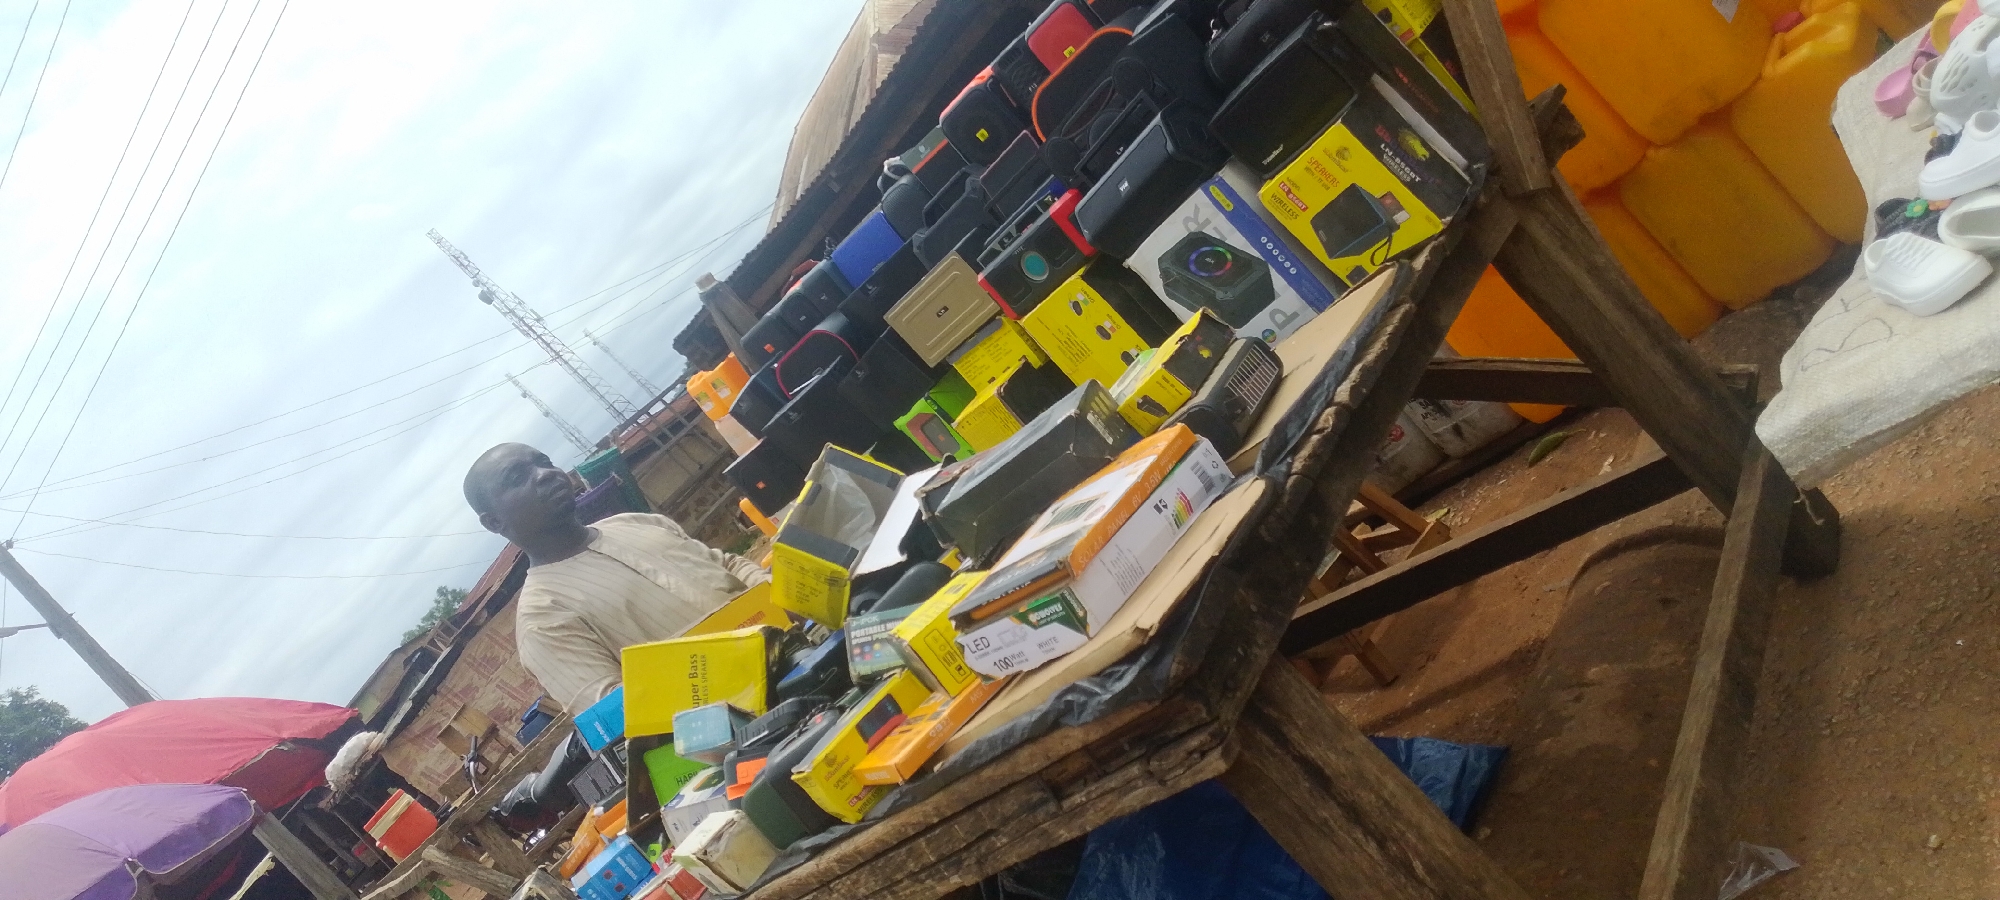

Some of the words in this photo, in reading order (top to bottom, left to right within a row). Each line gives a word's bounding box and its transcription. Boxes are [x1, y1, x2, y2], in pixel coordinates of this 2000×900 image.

[1307, 156, 1340, 188] SPEAKERS
[1270, 193, 1299, 219] WIRELESS
[1078, 538, 1106, 566] SOLAR
[1107, 509, 1131, 535] PANEL
[966, 635, 990, 654] LED
[1036, 635, 1059, 650] WHITE
[689, 653, 698, 679] Bass
[691, 683, 702, 708] uper
